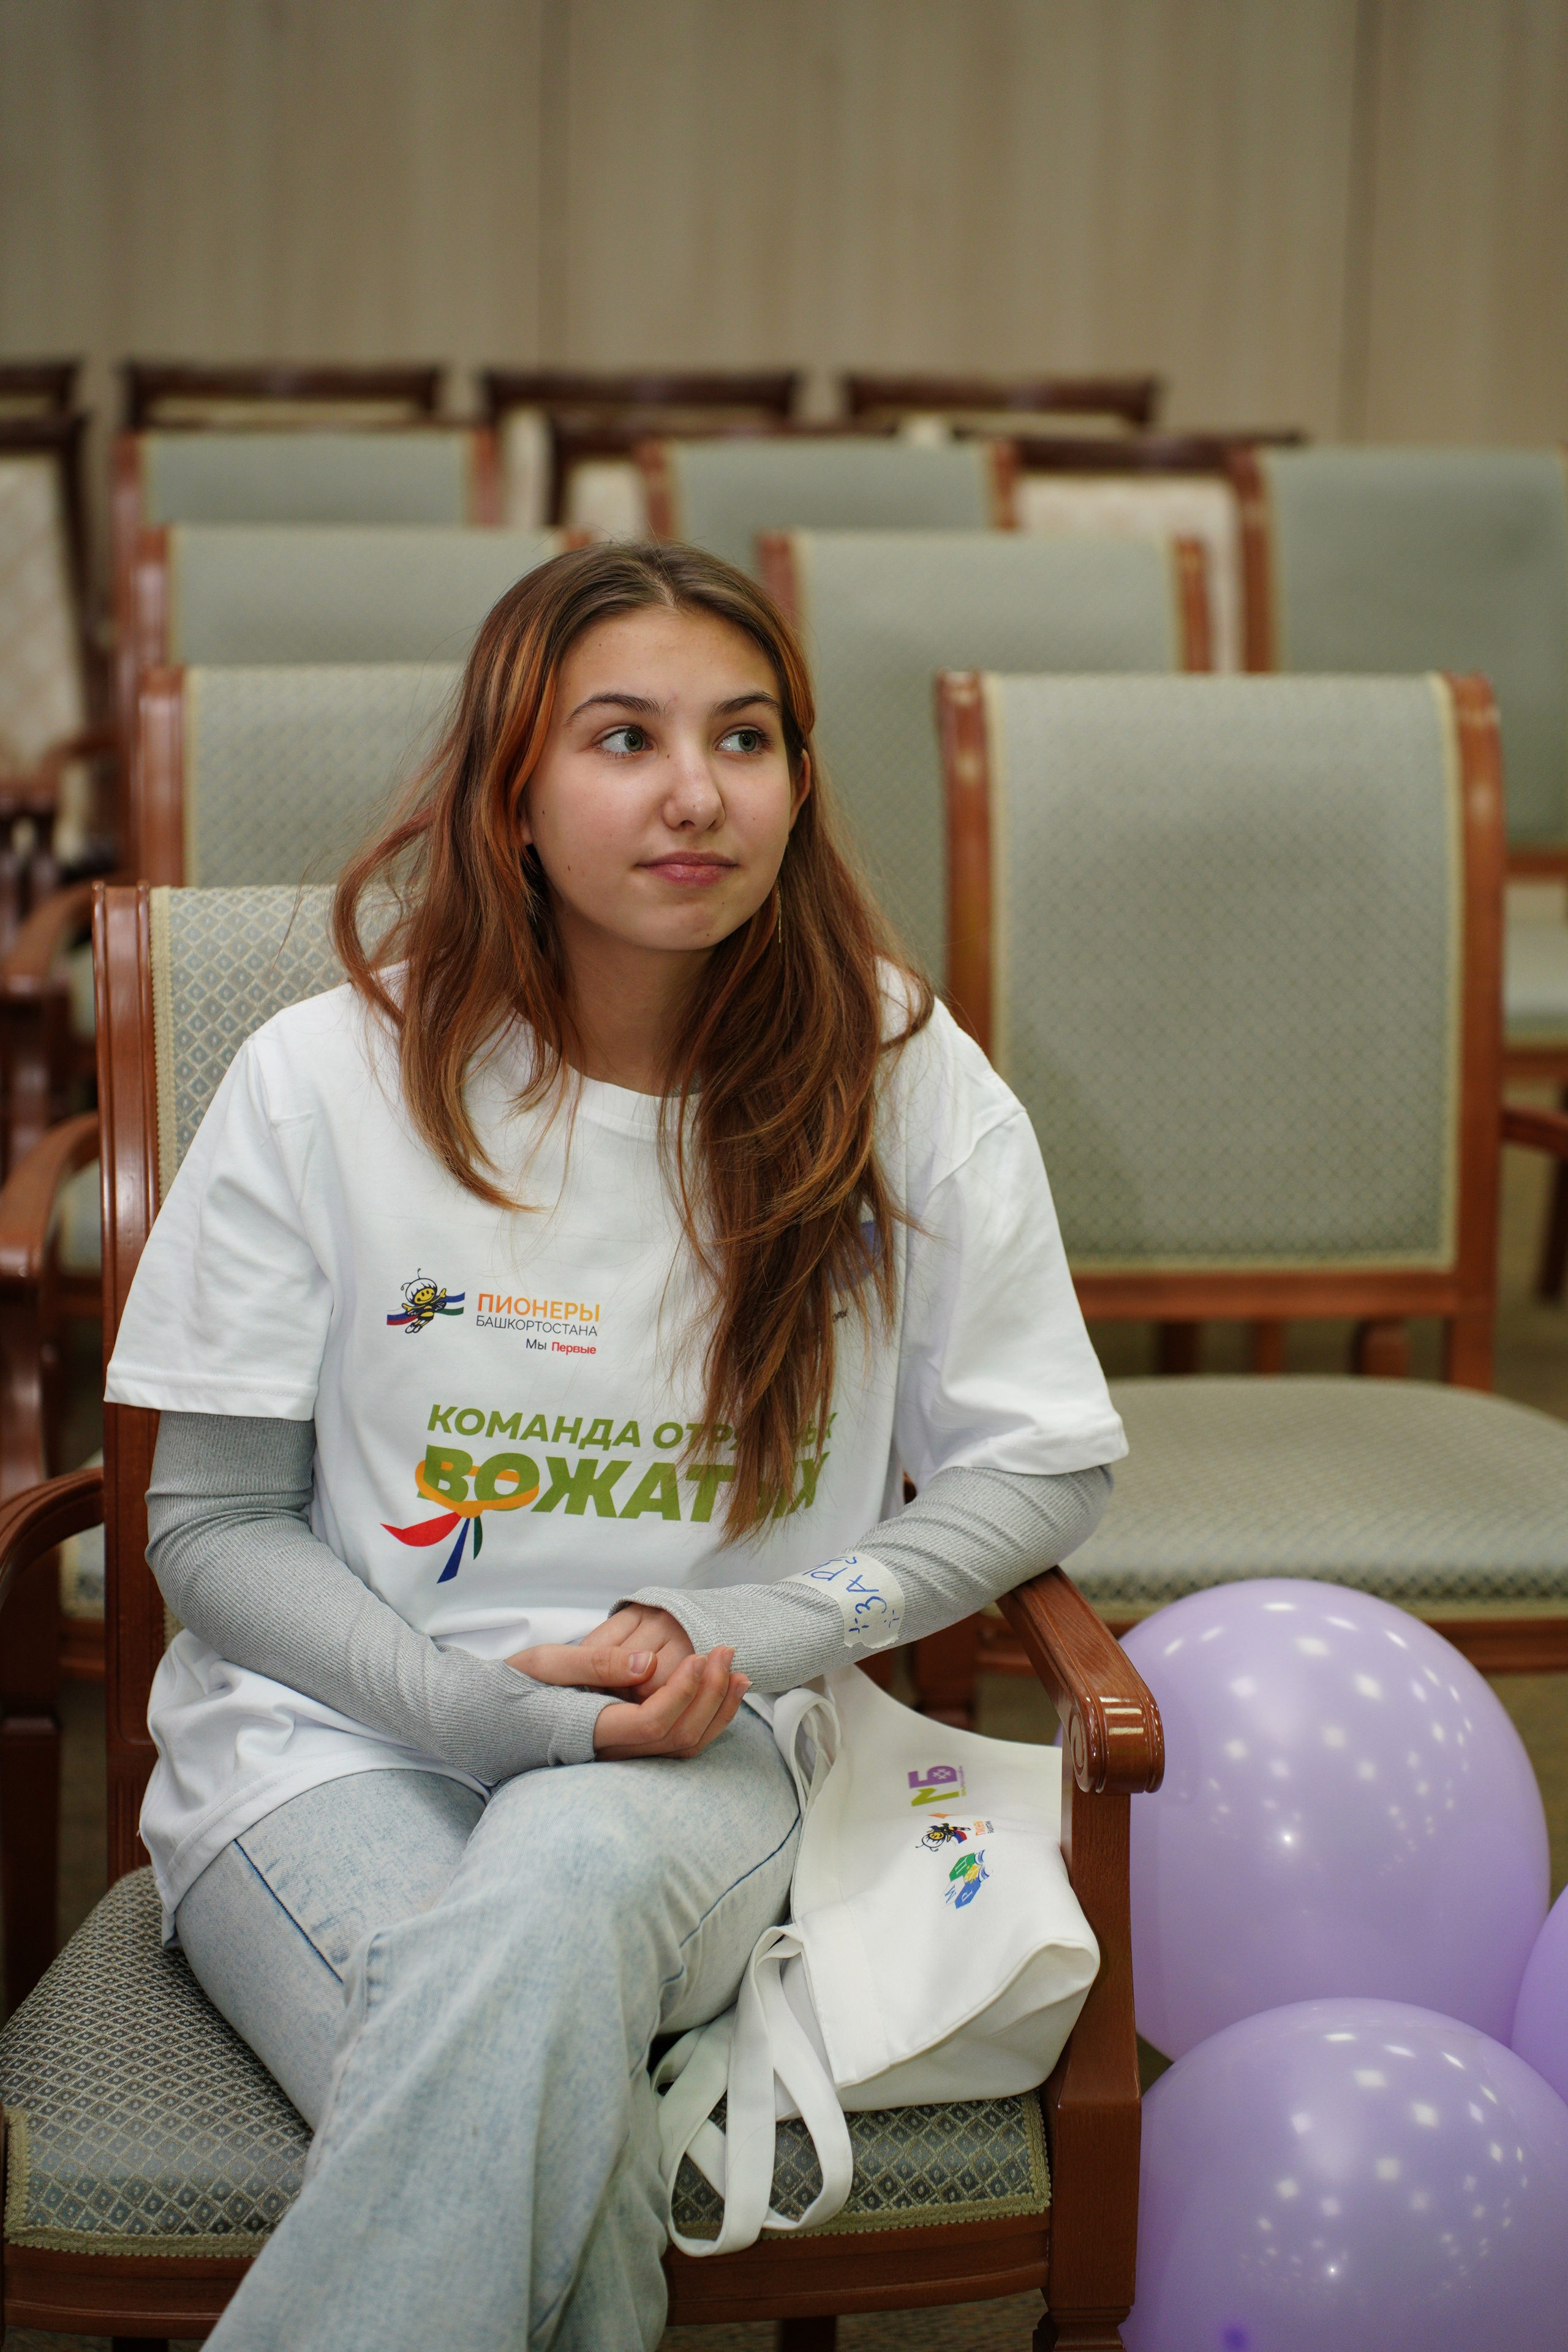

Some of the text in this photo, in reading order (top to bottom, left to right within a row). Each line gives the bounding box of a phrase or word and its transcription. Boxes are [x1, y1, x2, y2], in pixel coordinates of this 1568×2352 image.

[478, 1293, 600, 1322] ПИОНЕРЫ
[476, 1315, 598, 1336] БАШКОРТОСТАНА
[526, 1339, 597, 1355] Мы Первые
[427, 1404, 641, 1451] КОМАНДА
